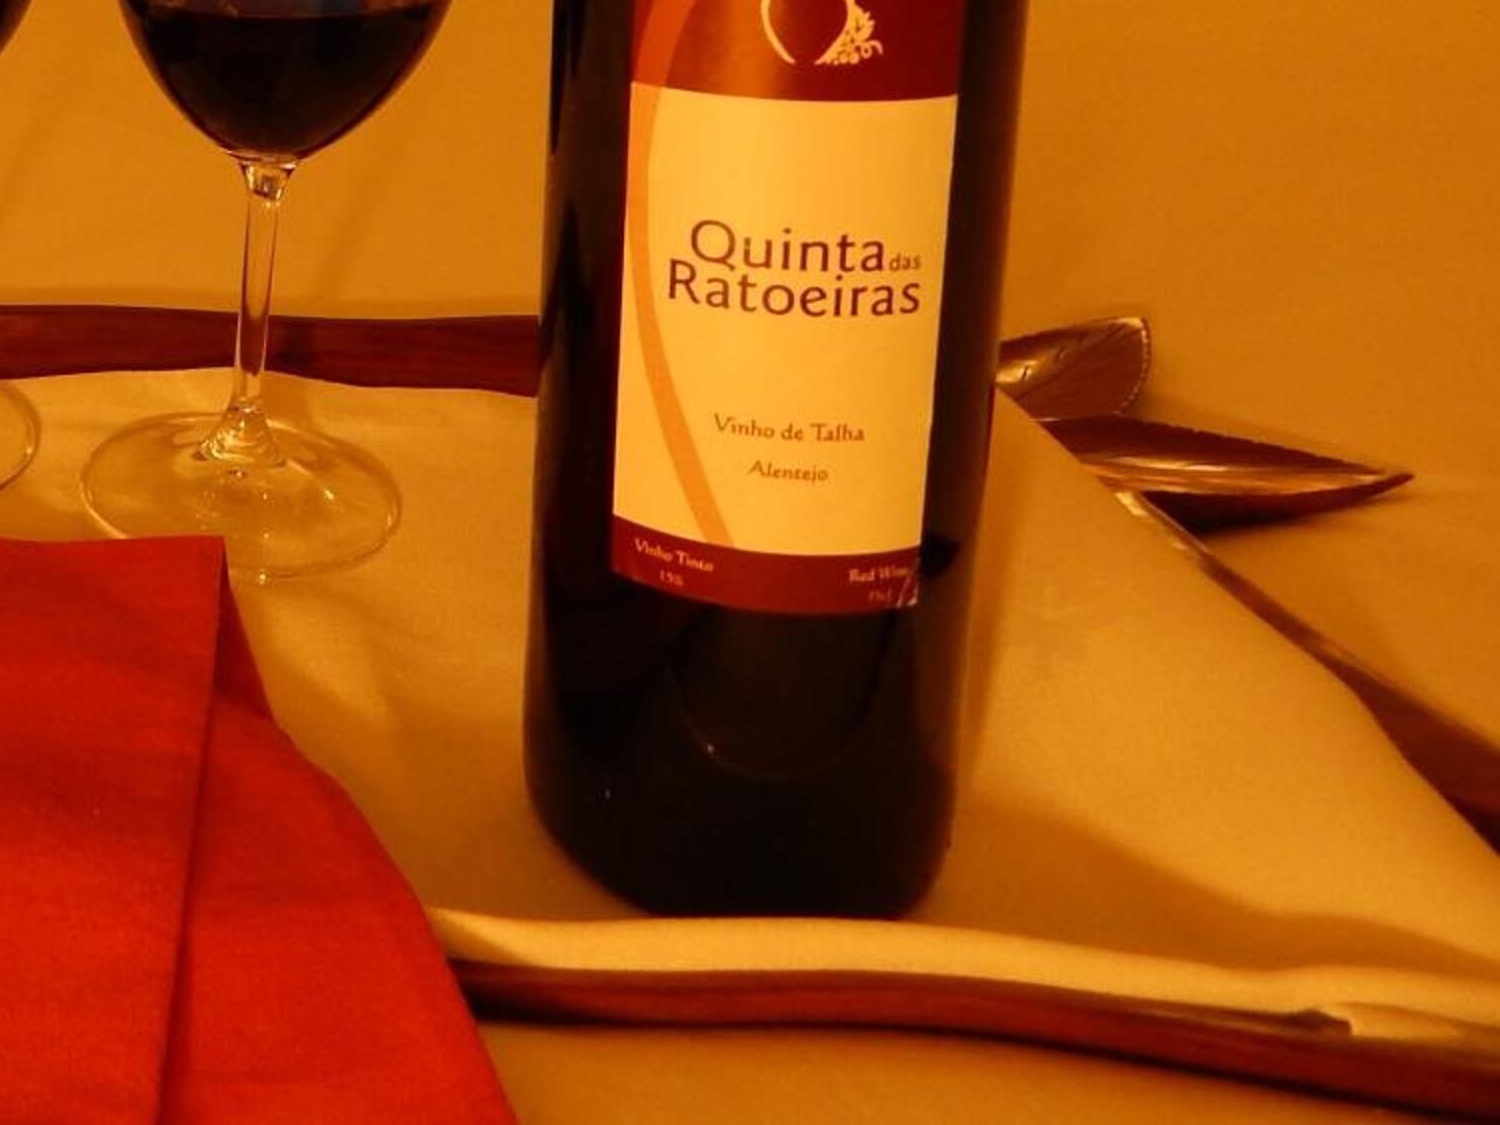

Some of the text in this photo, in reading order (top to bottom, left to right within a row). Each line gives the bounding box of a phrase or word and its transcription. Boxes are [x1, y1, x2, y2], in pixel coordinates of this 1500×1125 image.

[691, 220, 921, 272] Quinta das
[668, 258, 920, 317] Ratoeiras
[714, 412, 865, 442] Vinho de Talha
[748, 460, 829, 483] Alentejo
